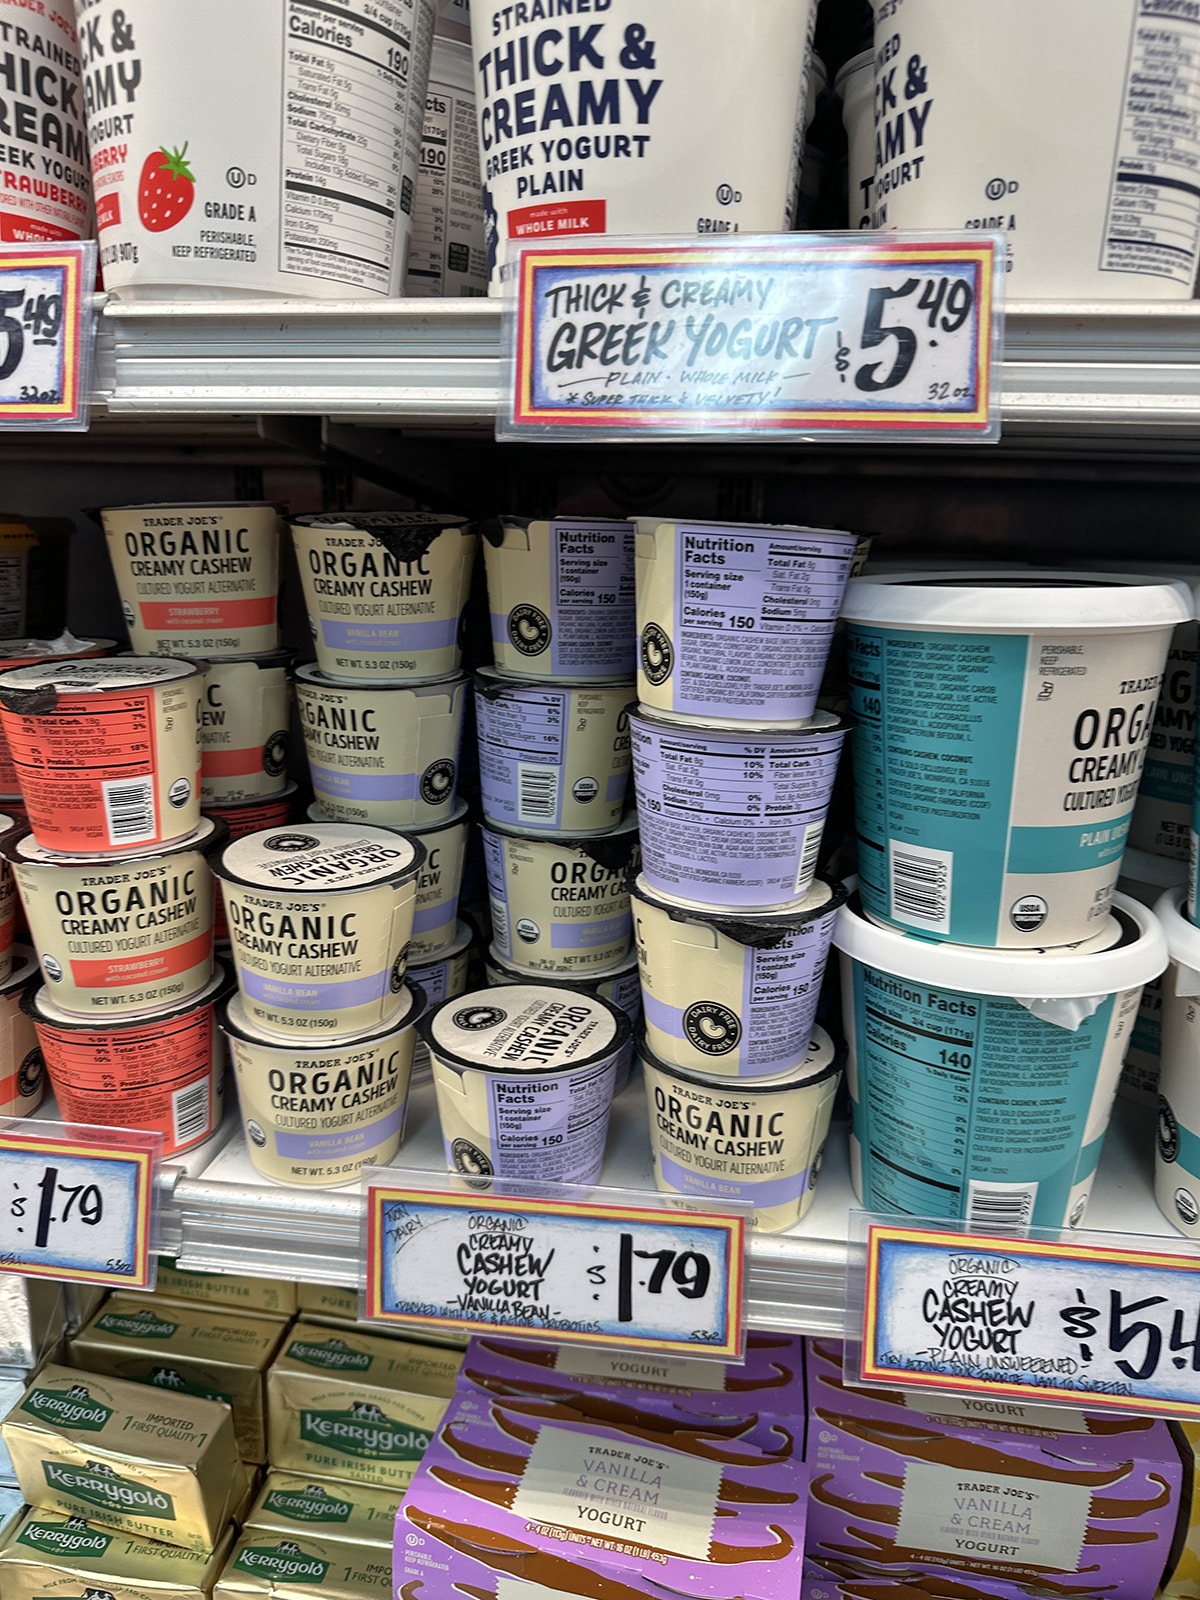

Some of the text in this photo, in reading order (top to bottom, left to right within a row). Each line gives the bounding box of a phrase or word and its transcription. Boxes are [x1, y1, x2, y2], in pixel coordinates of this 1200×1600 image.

[492, 0, 613, 36] STRAINED
[289, 15, 409, 76] Calories 190
[479, 23, 656, 98] THICK &
[482, 79, 664, 151] CREAMY
[487, 134, 651, 180] GREEK YOGURT
[517, 168, 584, 199] PLAIN
[205, 201, 257, 222] GRADE A
[516, 217, 589, 236] WHOLE MILK
[172, 245, 256, 262] KEEP REFRIGERATED
[544, 275, 775, 319] THICK & CREAMY
[546, 313, 839, 372] GREEK YOGURT
[604, 371, 662, 388] PLAIN
[582, 391, 625, 406] SUPER
[927, 382, 951, 400] 32
[143, 516, 218, 527] TRADER JOE'S
[125, 528, 250, 557] ORGANIC
[325, 537, 365, 547] TRADER
[559, 531, 616, 544] Nutrition
[684, 536, 754, 553] Nutrition
[559, 543, 594, 554] Facts
[684, 550, 726, 565] Facts
[130, 557, 252, 576] CREAMY CASHEW
[308, 548, 431, 577] ORGANIC
[684, 569, 744, 582] Serving size
[313, 578, 433, 597] CREAMY CASHEW
[684, 589, 709, 601] (150g)
[683, 606, 726, 619] Calories
[58, 717, 83, 725] Carb.
[324, 731, 380, 751] CASHEW
[743, 761, 764, 769] 10%
[743, 771, 763, 779] 10%
[662, 784, 703, 798] Cholesterol
[747, 794, 761, 802] 0%
[81, 867, 166, 886] TRADER JOE'S
[281, 848, 402, 885] ORGANIC
[55, 870, 194, 916] ORGANIC
[243, 894, 320, 912] TRADER JOE'S
[551, 884, 607, 902] CREAMY
[62, 896, 197, 936] CREAMY CASHEW
[229, 899, 357, 939] ORGANIC
[68, 917, 200, 954] CULTURED YOGURT ALTERNATIVE
[234, 926, 359, 959] CREAMY CASHEW
[107, 956, 166, 974] STRAWBERRY
[270, 959, 302, 977] YOGURT
[304, 959, 362, 977] ALTERNATIVE
[92, 997, 110, 1006] NET
[129, 992, 144, 1003] 5.3
[145, 990, 158, 999] OZ
[159, 982, 184, 998] (150g)
[263, 983, 319, 997] VANILLA BEAN
[863, 966, 976, 1017] Nutrition Facts
[281, 1015, 294, 1025] 5.3
[296, 1017, 307, 1026] OZ
[309, 1017, 338, 1027] (150g)
[690, 1006, 738, 1030] DAIRY FREE
[523, 1005, 594, 1065] ORGANIC
[688, 1026, 733, 1051] DAIRY FREE
[866, 1022, 971, 1069] Calories 140
[295, 1051, 375, 1069] TRADER JOE'S
[268, 1050, 400, 1094] ORGANIC
[271, 1074, 399, 1112] CREAMY CASHEW
[496, 1081, 559, 1094] Nutrition
[672, 1085, 750, 1110] TRADER JOE'S
[497, 1094, 535, 1103] Facts
[275, 1093, 399, 1129] CULTURED YOGURT ALTERNATIVE
[654, 1086, 785, 1138] ORGANIC
[500, 1133, 563, 1146] Calories 150
[656, 1112, 785, 1157] CREAMY CASHEW
[660, 1134, 785, 1175] CULTURED YOGURT ALTERNATIVE
[683, 1173, 741, 1194] VANILLA BEAN
[386, 1214, 425, 1243] DAIRY
[468, 1215, 526, 1232] ORGANIC
[469, 1233, 534, 1256] CREAMY
[457, 1242, 555, 1278] CASHEW
[949, 1257, 1015, 1275] ORGANIC
[464, 1275, 545, 1301] YOGURT
[943, 1279, 1019, 1302] CREAMY
[511, 1300, 550, 1320] BEAN
[922, 1288, 1035, 1328] CASHEW
[933, 1322, 1022, 1355] YOGURT
[609, 1361, 671, 1377] YOGURT
[962, 1398, 1026, 1417] YOGURT
[133, 1420, 156, 1435] FIRST
[157, 1426, 199, 1443] QUALITY
[146, 1413, 194, 1431] IMPORTED
[306, 1452, 337, 1466] PURE
[341, 1457, 376, 1473] IRISH
[588, 1446, 664, 1469] TRADER JOE'S
[583, 1459, 662, 1489] VANILLA
[576, 1474, 660, 1505] & CREAM
[957, 1482, 1034, 1501] TRADER JOE'S
[57, 1500, 175, 1538] PURE IRISH BUTTER
[577, 1505, 647, 1532] YOGURT
[953, 1497, 1033, 1520] VANILLA
[950, 1513, 1030, 1535] & CREAM
[132, 1546, 159, 1556] FIRST
[160, 1549, 202, 1562] QUALITY
[954, 1538, 1020, 1556] YOGURT
